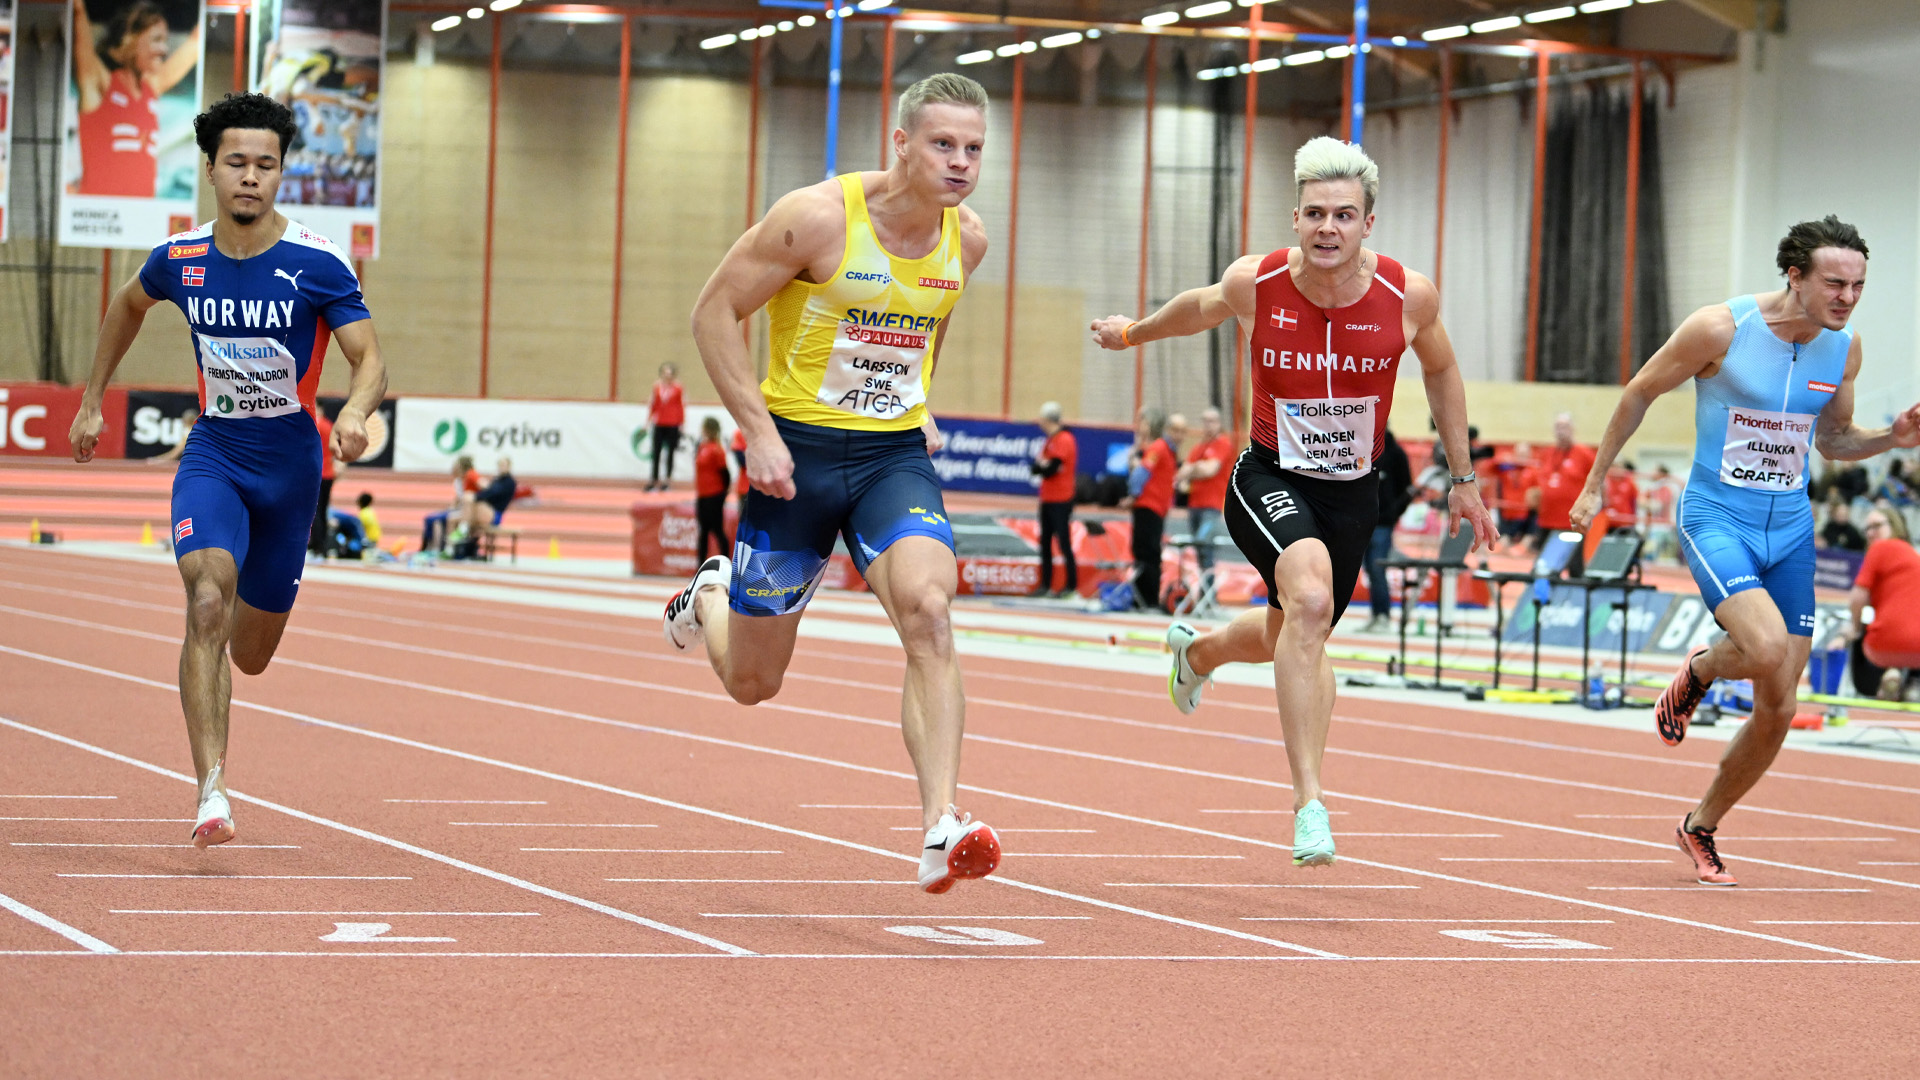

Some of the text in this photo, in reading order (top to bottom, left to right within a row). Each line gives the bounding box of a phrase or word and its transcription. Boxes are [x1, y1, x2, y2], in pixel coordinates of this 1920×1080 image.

[183, 246, 206, 256] EXTRA
[846, 271, 883, 282] CRAFT
[919, 278, 959, 289] BAUHAUS
[187, 296, 294, 328] NORWAY
[1345, 323, 1373, 331] CRAFT
[861, 331, 926, 348] BAUHAUS
[209, 341, 279, 360] Folksam
[853, 357, 909, 376] LARSSON
[1262, 347, 1392, 373] DENMARK
[235, 385, 262, 394] NOR
[864, 378, 892, 390] SWE
[239, 396, 288, 411] cytiva
[1301, 400, 1367, 418] folkspel
[1733, 413, 1783, 431] Prioritet
[478, 422, 561, 449] cytiva
[1301, 430, 1355, 444] HANSEN
[1306, 449, 1329, 459] DEN
[1338, 447, 1354, 457] ISL
[1747, 441, 1795, 455] ILLUKKA
[1761, 457, 1778, 467] FIN
[1732, 467, 1786, 484] CRAFT
[1260, 490, 1298, 522] DEN
[746, 585, 801, 597] CRAFT
